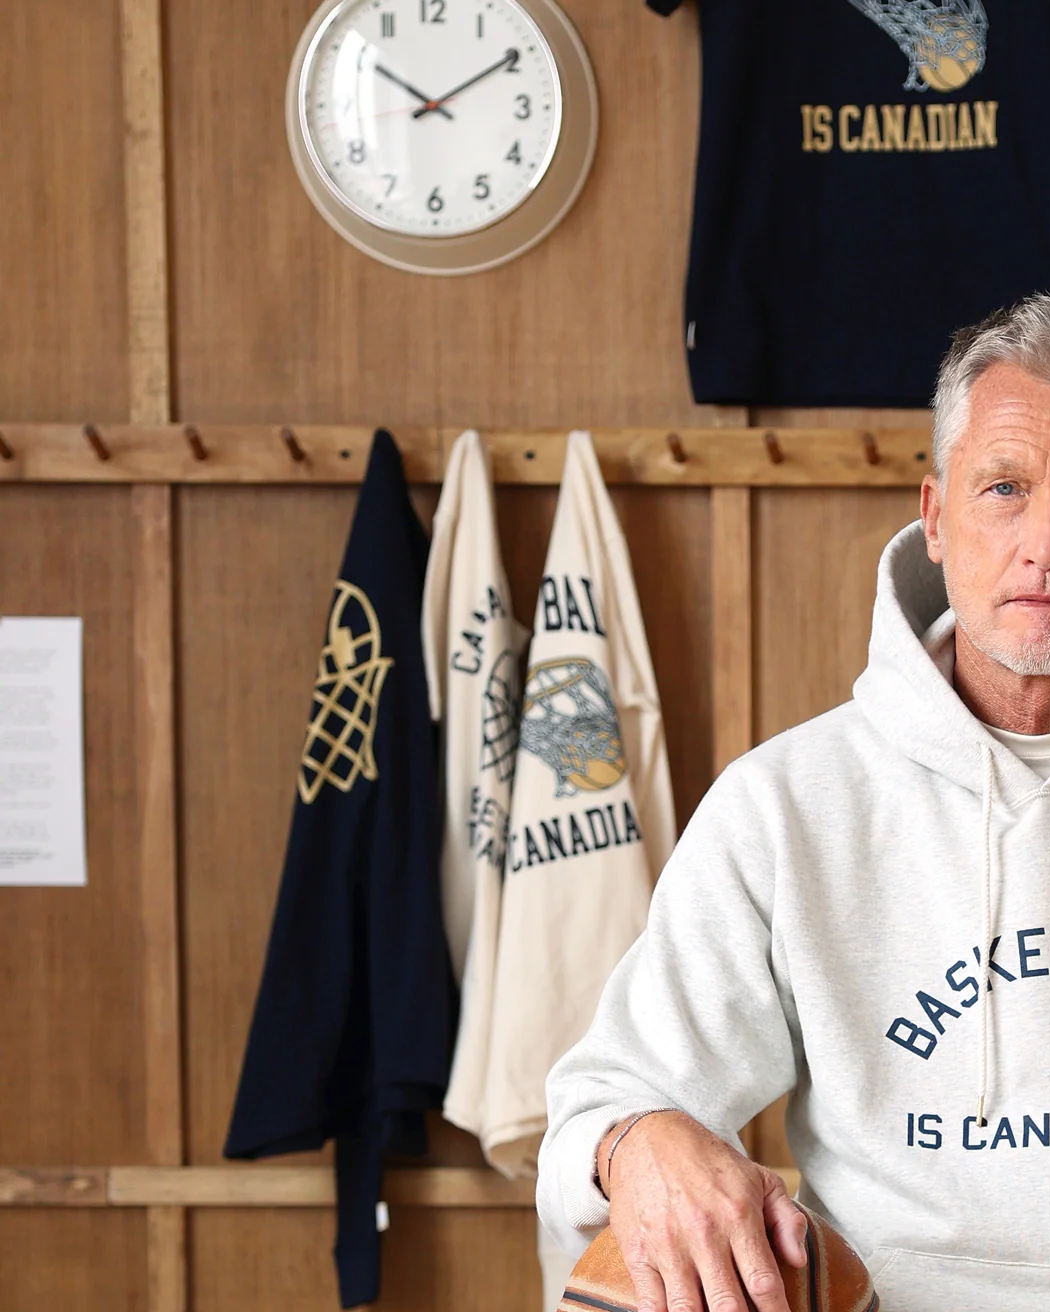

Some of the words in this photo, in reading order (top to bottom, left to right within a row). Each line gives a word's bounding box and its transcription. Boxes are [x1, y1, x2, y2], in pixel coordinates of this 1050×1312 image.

[419, 0, 447, 23] 12
[514, 94, 532, 120] 3
[801, 104, 833, 153] IS
[839, 101, 999, 152] CANADIAN
[349, 140, 366, 165] 8
[506, 139, 522, 166] 4
[382, 175, 397, 198] 7
[473, 175, 491, 201] 5
[427, 187, 445, 213] 6
[907, 1112, 943, 1150] IS
